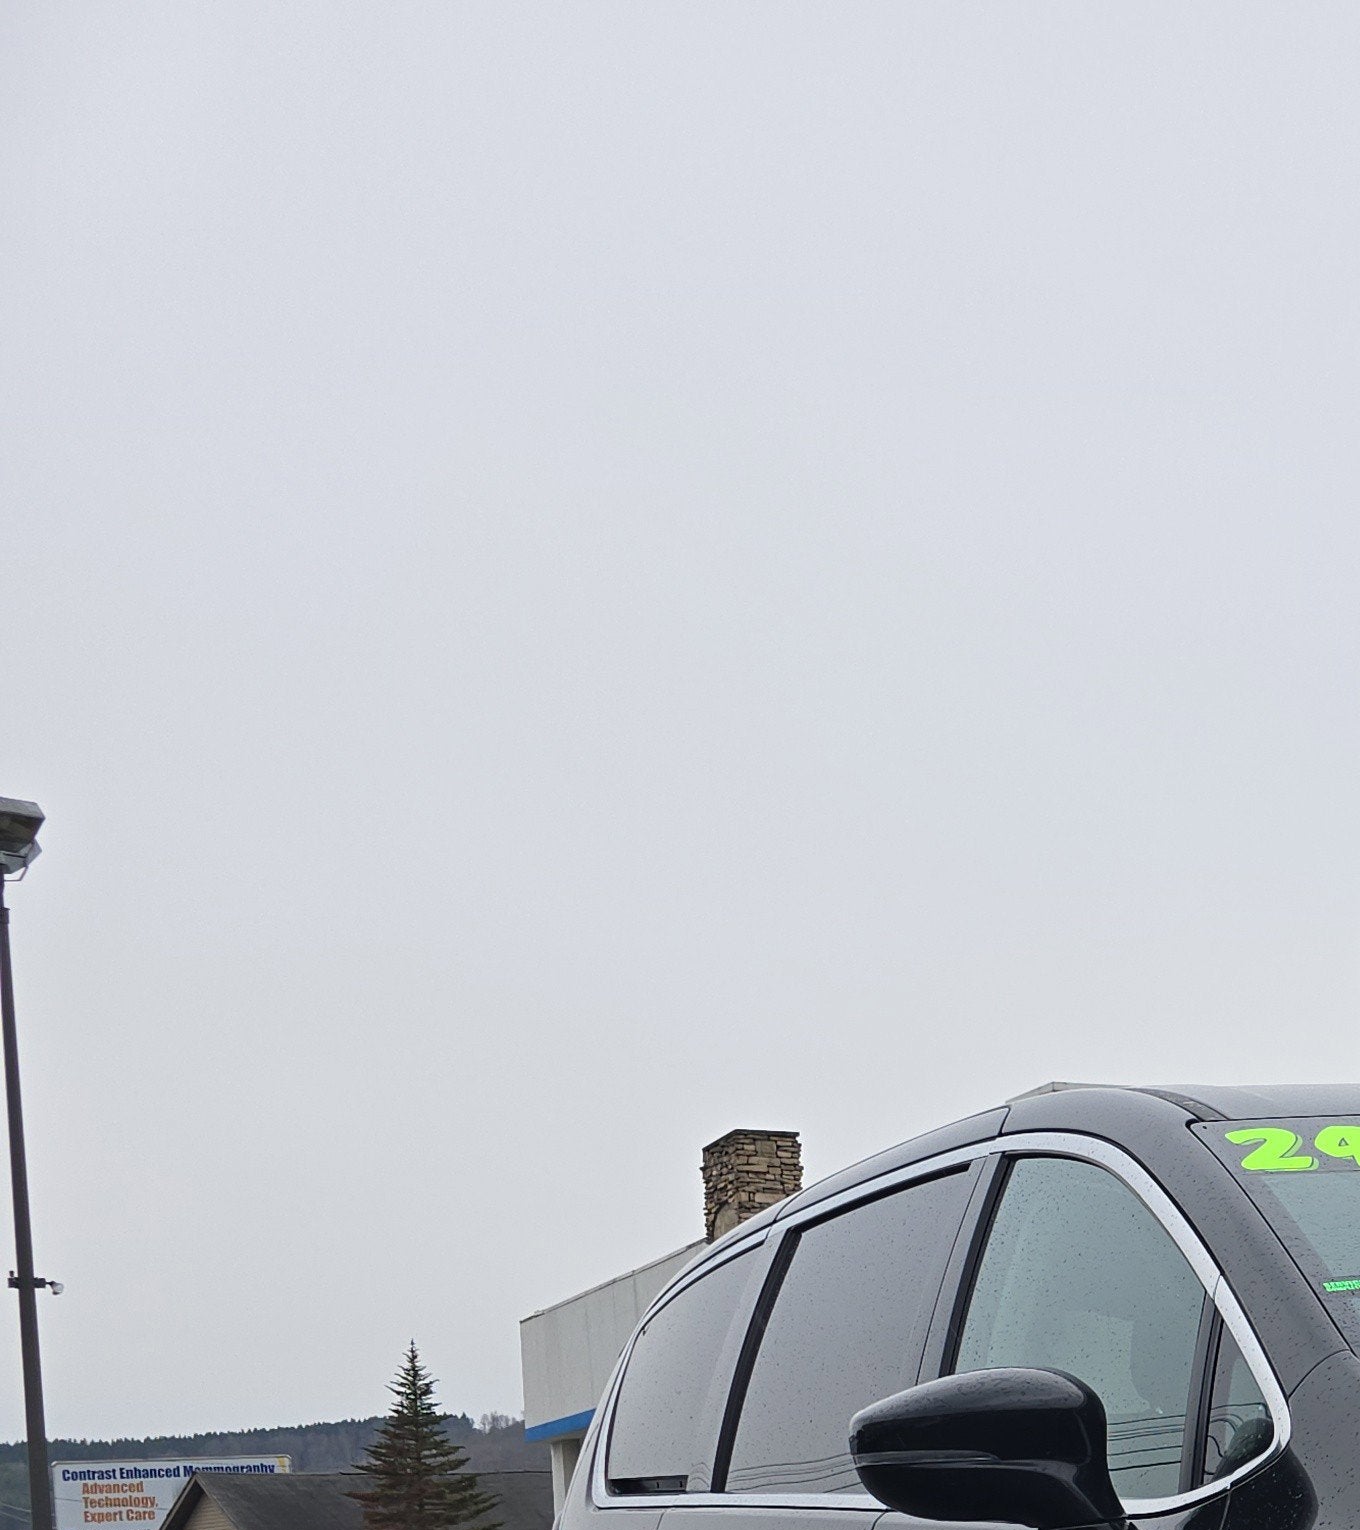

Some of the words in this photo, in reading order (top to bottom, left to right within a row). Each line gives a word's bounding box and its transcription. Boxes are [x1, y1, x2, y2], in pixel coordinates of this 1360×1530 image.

[62, 1468, 117, 1481] Contrast
[119, 1466, 180, 1479] Enhanced
[82, 1481, 144, 1494] Advanced
[84, 1510, 123, 1524] Expert
[126, 1509, 155, 1521] Care
